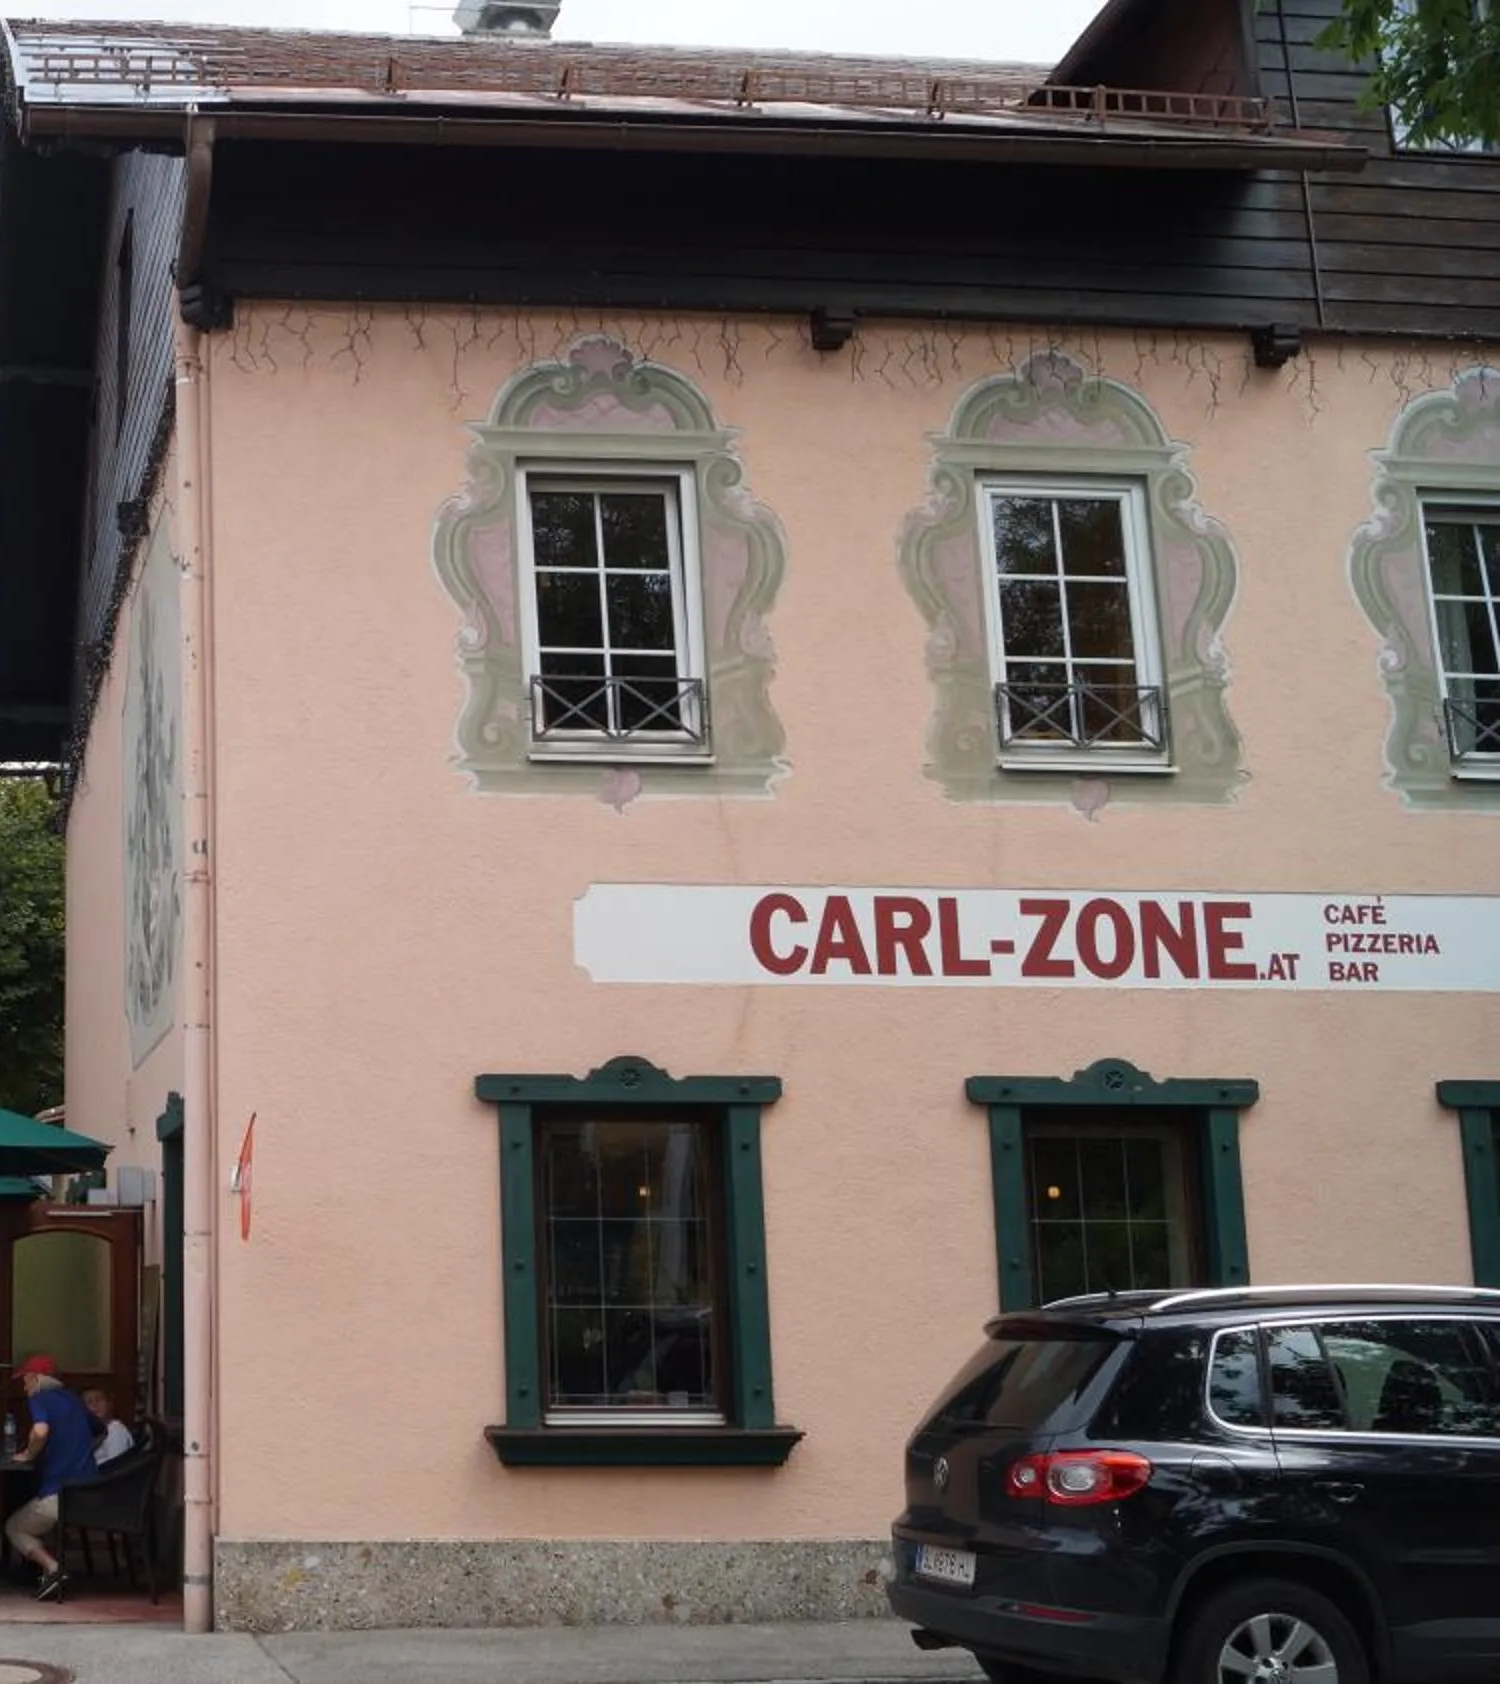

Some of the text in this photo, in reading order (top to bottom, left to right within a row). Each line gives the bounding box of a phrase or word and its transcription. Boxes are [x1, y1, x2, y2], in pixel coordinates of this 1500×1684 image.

[1323, 896, 1387, 925] CAFÉ
[1325, 932, 1441, 954] PIZZERIA
[1328, 961, 1380, 982] BAR
